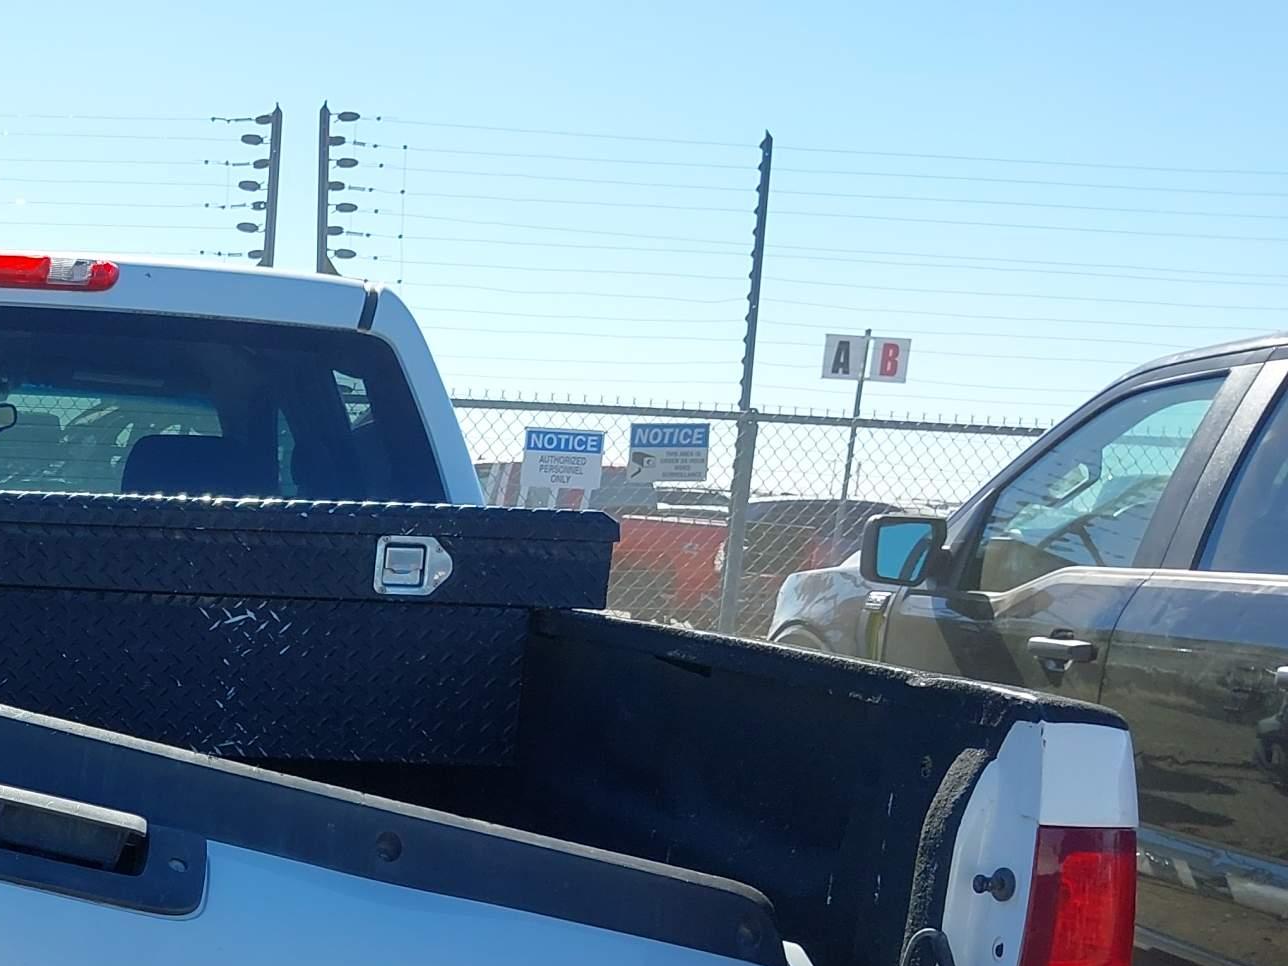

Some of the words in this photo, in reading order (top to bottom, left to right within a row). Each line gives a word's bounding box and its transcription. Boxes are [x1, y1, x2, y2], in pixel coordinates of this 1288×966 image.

[831, 340, 850, 375] A
[879, 342, 900, 377] B
[530, 433, 599, 451] NOTICE
[634, 428, 705, 445] NOTICE
[538, 455, 587, 466] AUTHORIZED
[538, 464, 584, 475] PERSONNEL
[550, 474, 572, 484] ONLY
